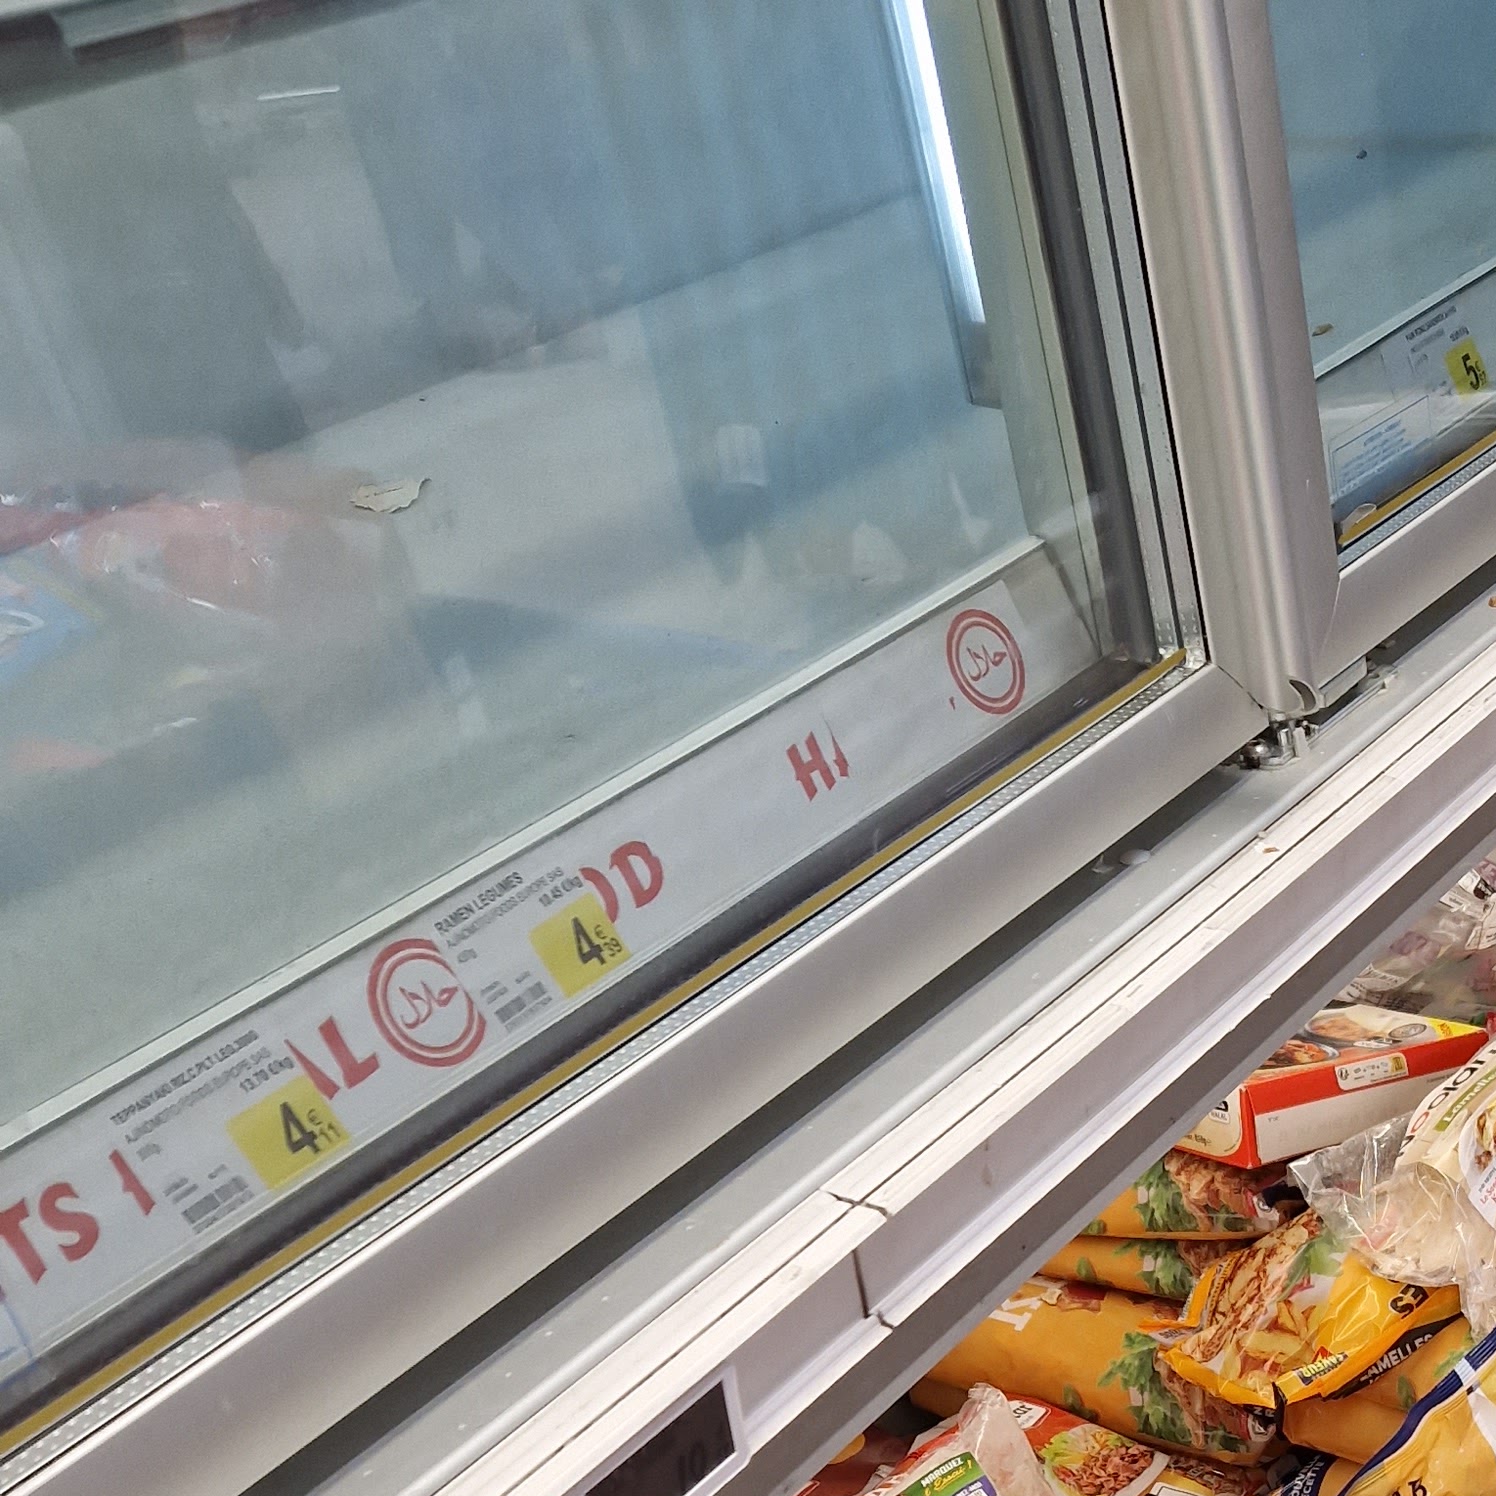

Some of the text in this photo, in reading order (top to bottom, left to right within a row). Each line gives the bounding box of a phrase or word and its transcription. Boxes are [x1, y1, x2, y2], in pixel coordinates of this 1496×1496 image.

[1462, 353, 1479, 390] 5
[433, 901, 476, 936] RAMEN
[571, 917, 606, 966] 4
[280, 1101, 320, 1153] 4
